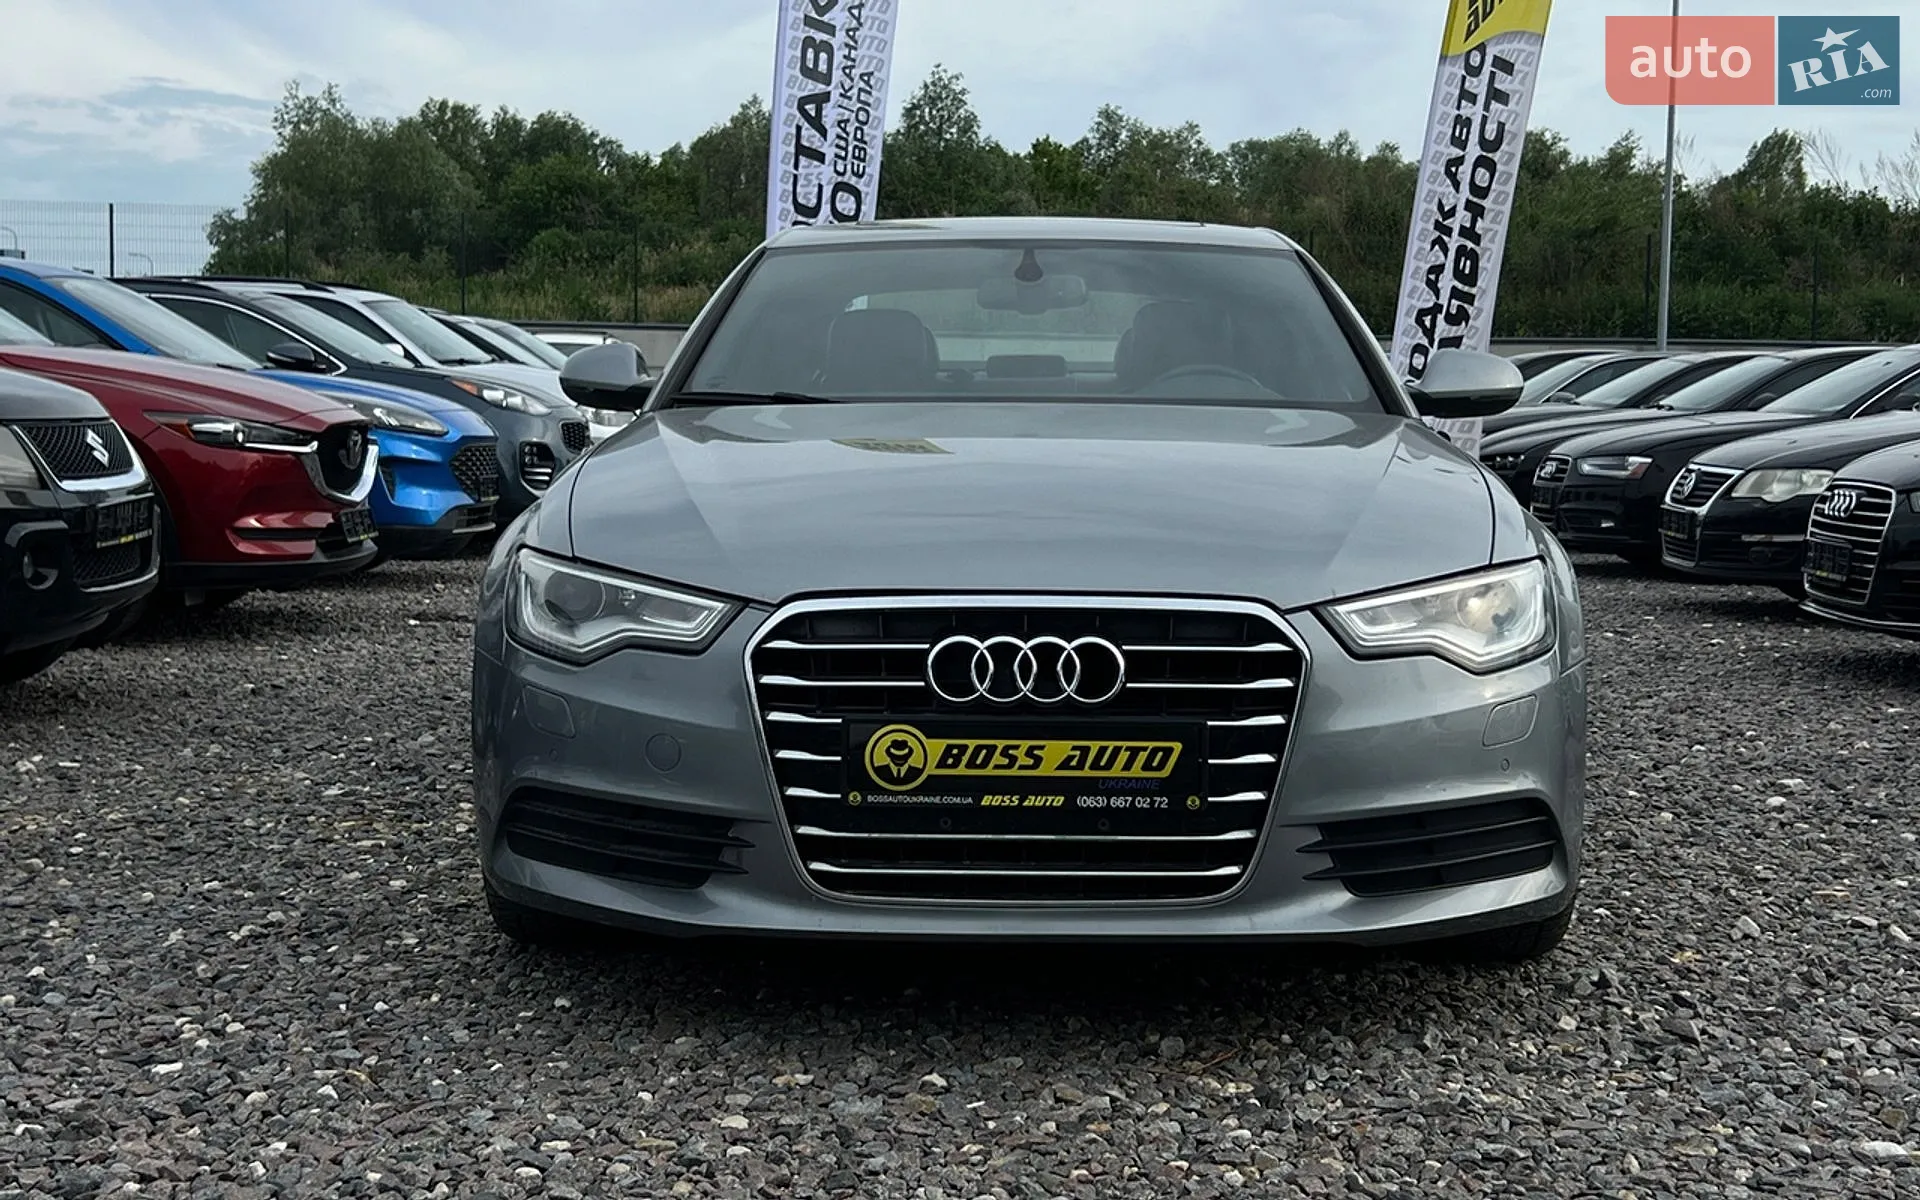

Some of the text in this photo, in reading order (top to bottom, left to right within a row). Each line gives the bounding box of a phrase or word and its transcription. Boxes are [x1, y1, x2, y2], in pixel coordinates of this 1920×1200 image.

[791, 0, 840, 226] СТАВК
[833, 118, 851, 177] США
[1404, 42, 1487, 384] ОДАЖ АВТО
[934, 743, 1175, 773] BOSS AUTO
[1098, 779, 1160, 790] UKRAINE
[980, 795, 1065, 807] BOSS AUTO
[1076, 796, 1169, 808] (063) 667 02 72
